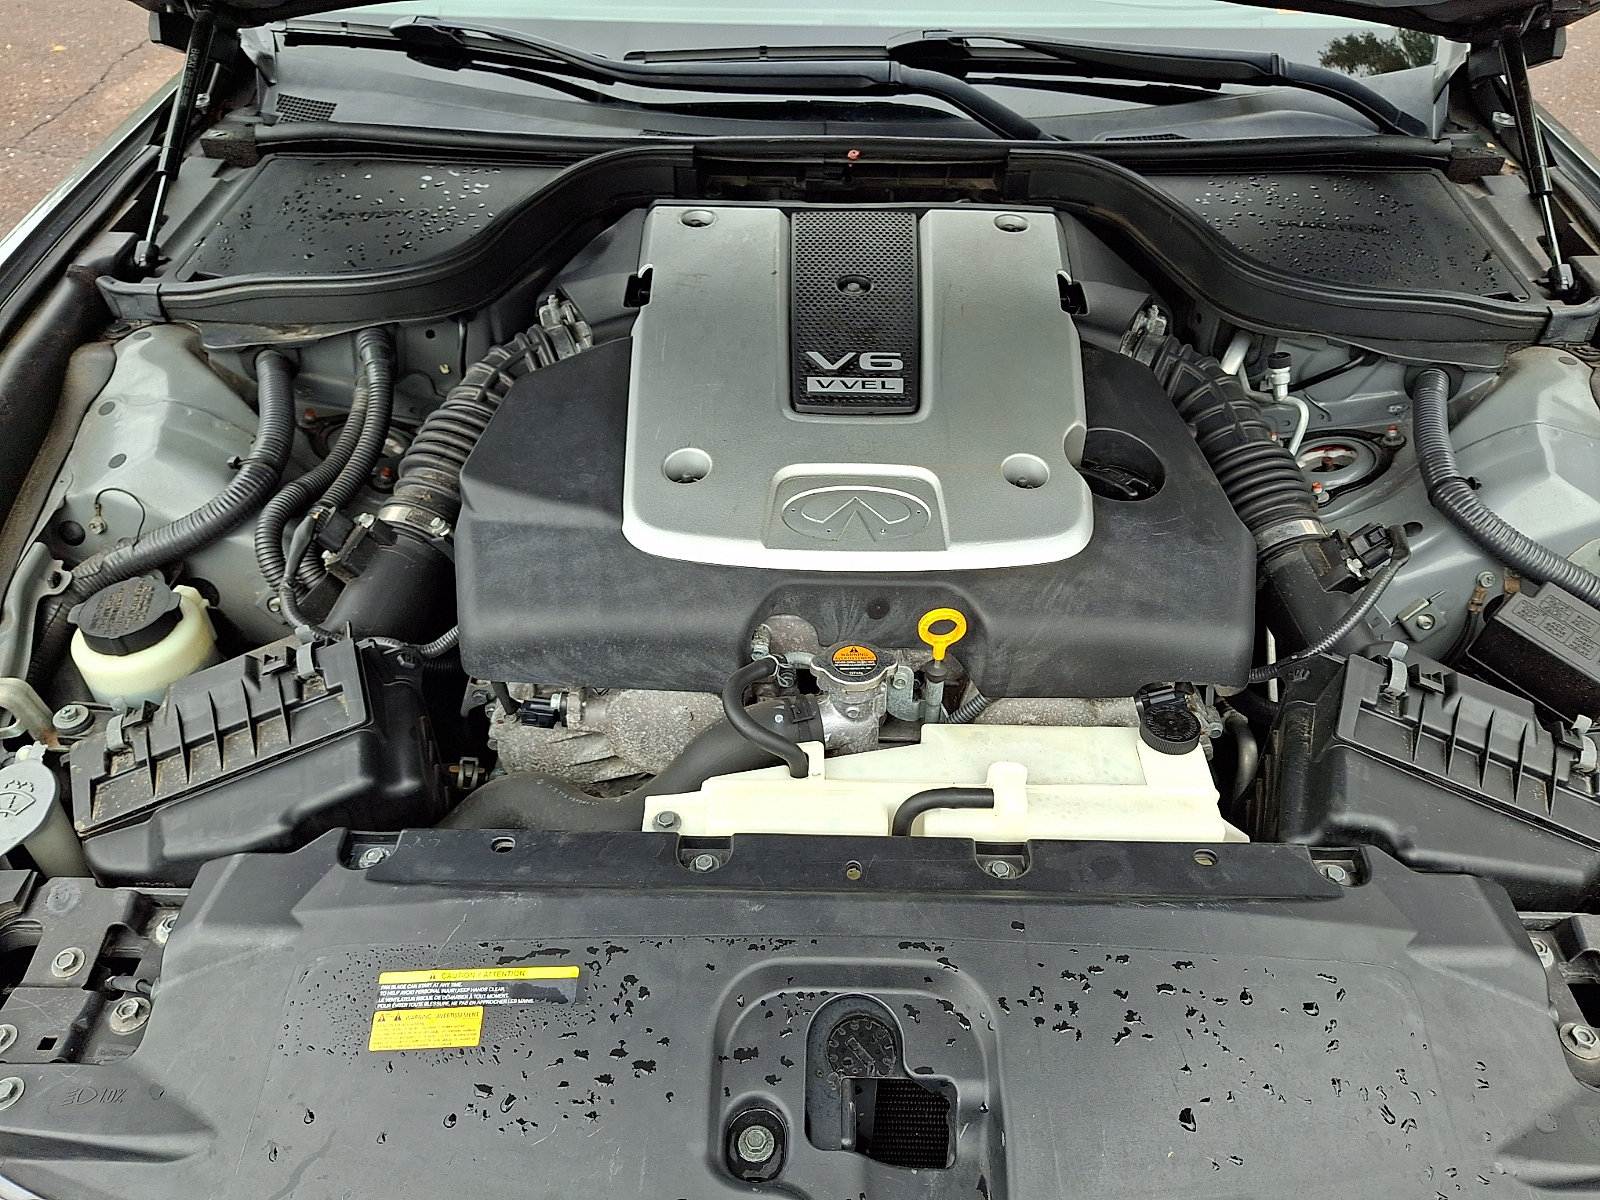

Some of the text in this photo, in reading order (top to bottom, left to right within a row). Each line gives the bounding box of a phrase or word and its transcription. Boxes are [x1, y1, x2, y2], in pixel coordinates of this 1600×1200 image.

[805, 351, 904, 371] V6
[815, 379, 896, 390] VVEL
[441, 972, 475, 980] CAUTION
[483, 970, 526, 978] ATTENTION
[436, 1011, 480, 1020] AVERTISSEMENT
